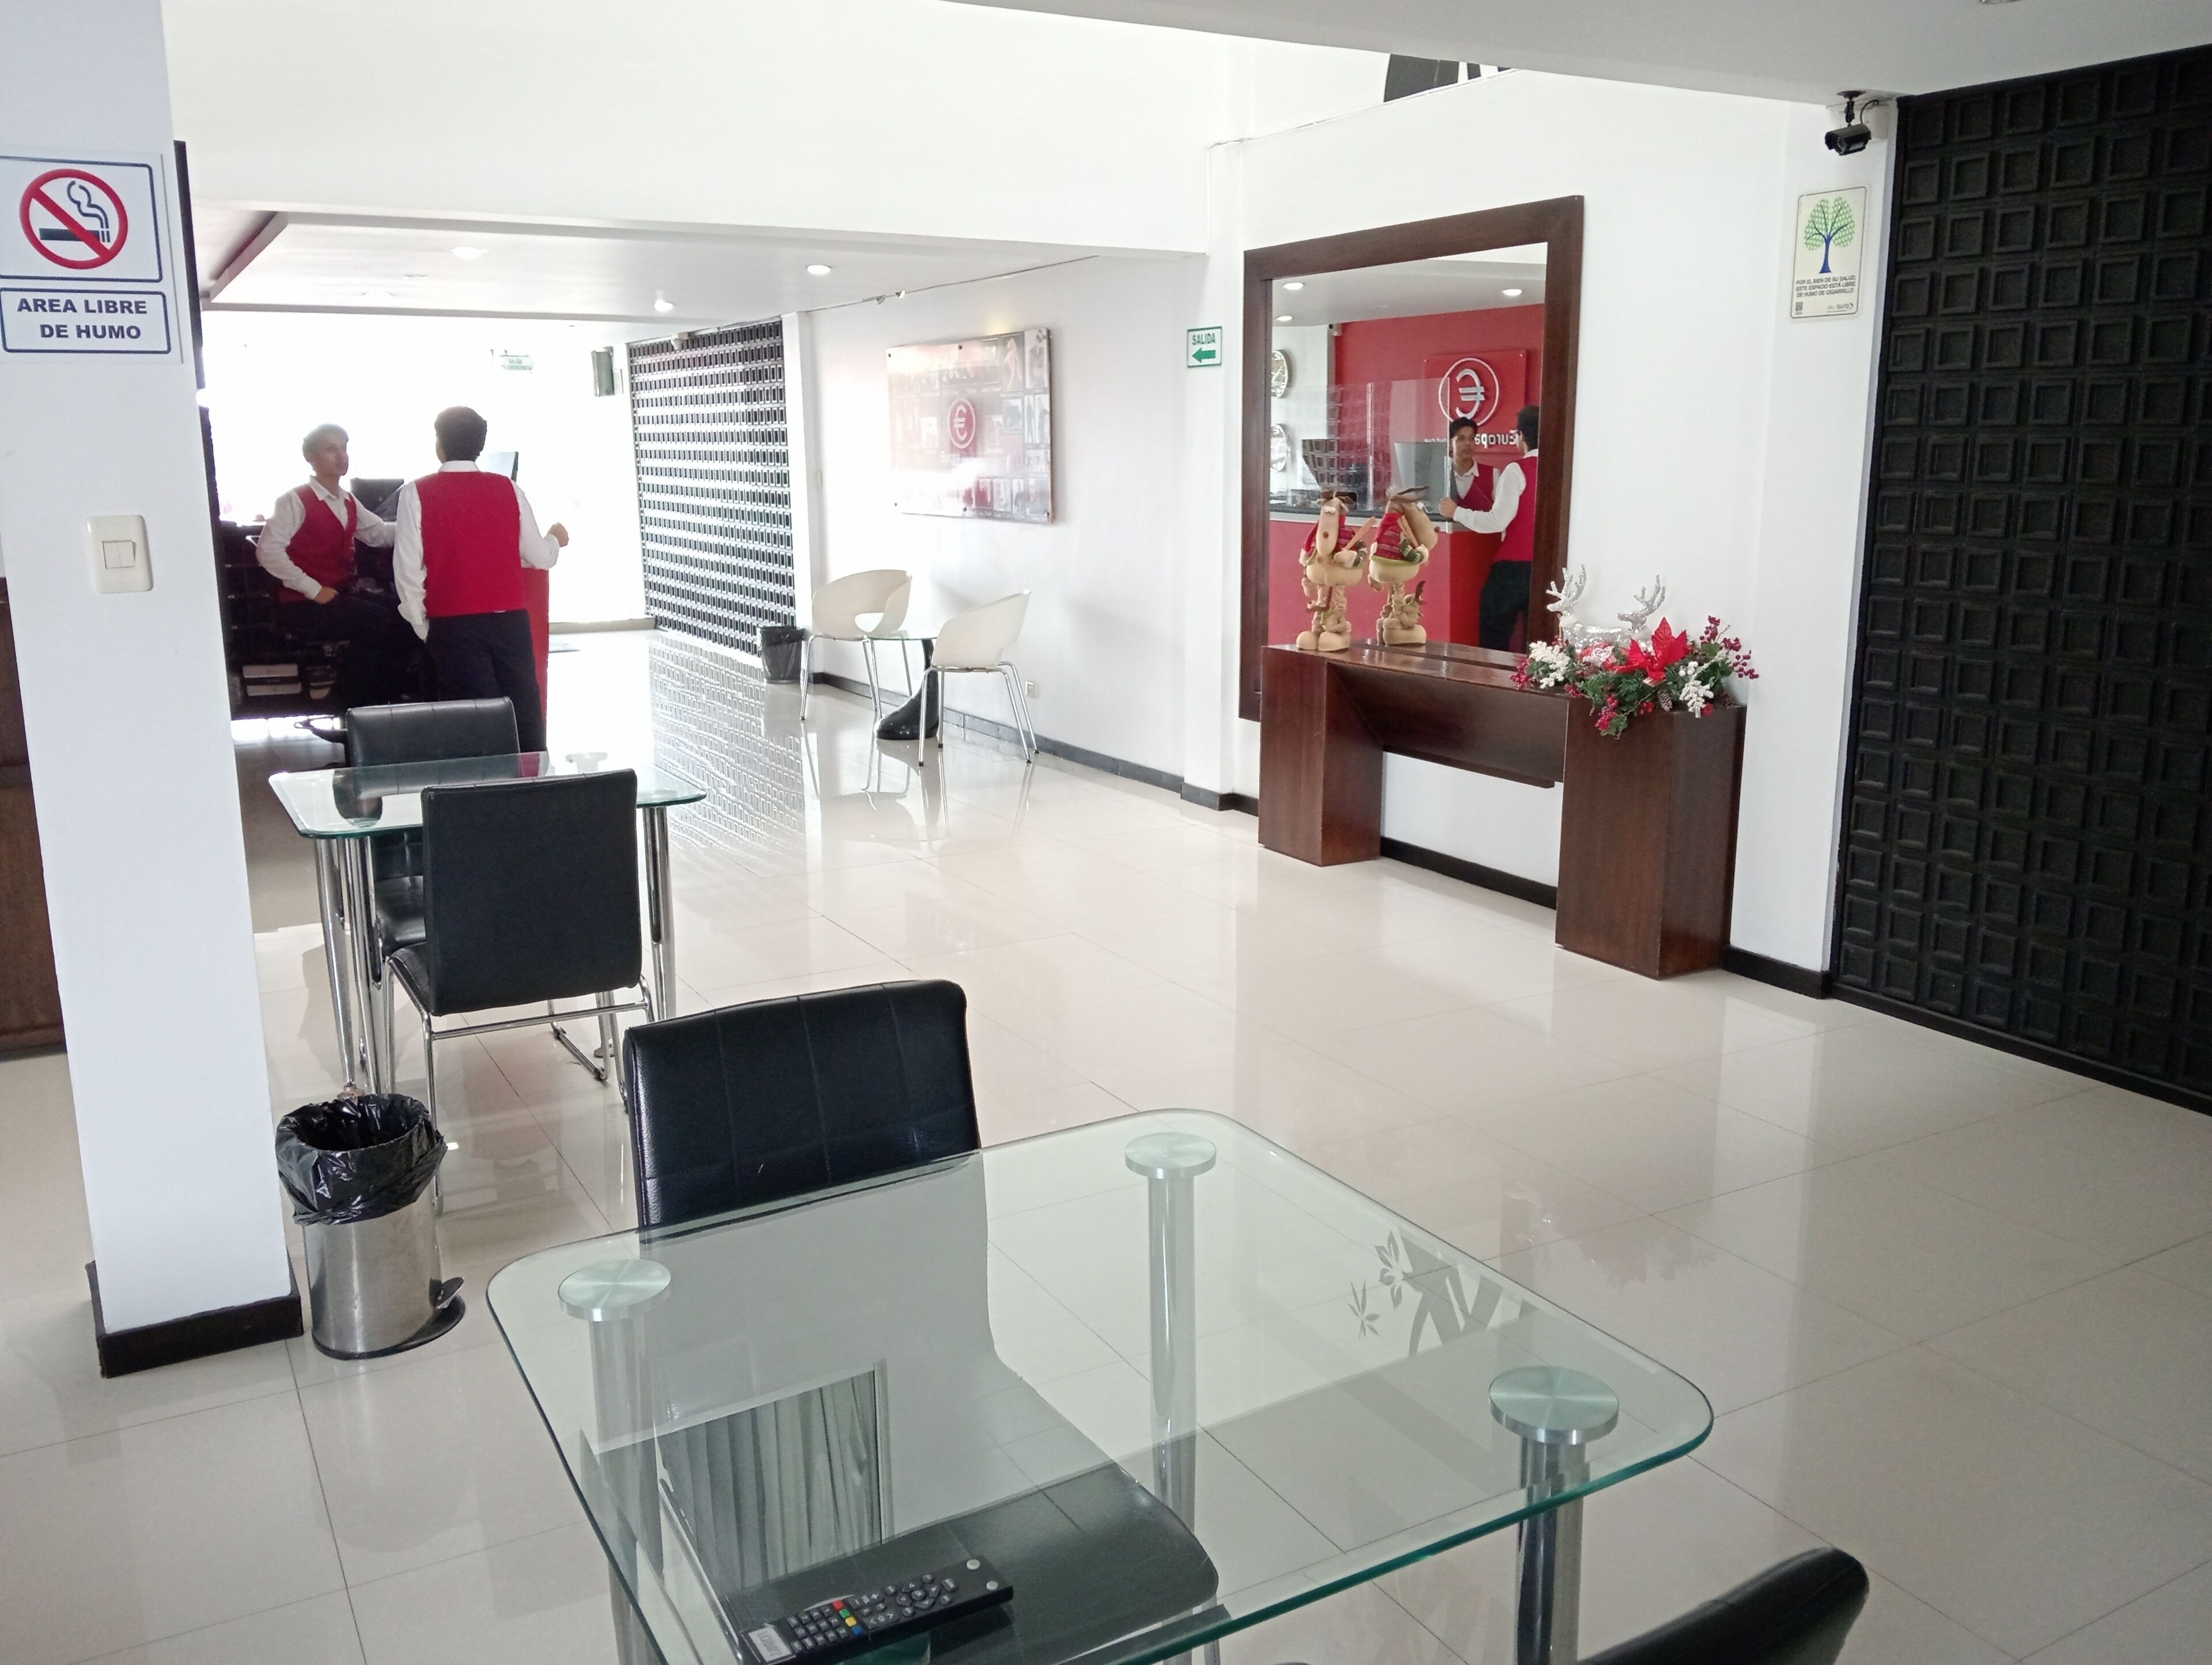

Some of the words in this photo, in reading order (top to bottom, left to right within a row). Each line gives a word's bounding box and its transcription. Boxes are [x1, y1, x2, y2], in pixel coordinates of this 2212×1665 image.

[17, 298, 78, 314] AREA
[84, 299, 148, 314] LIBRE
[40, 324, 69, 339] DE
[76, 324, 142, 339] HUMO
[1192, 332, 1216, 345] SALIDA
